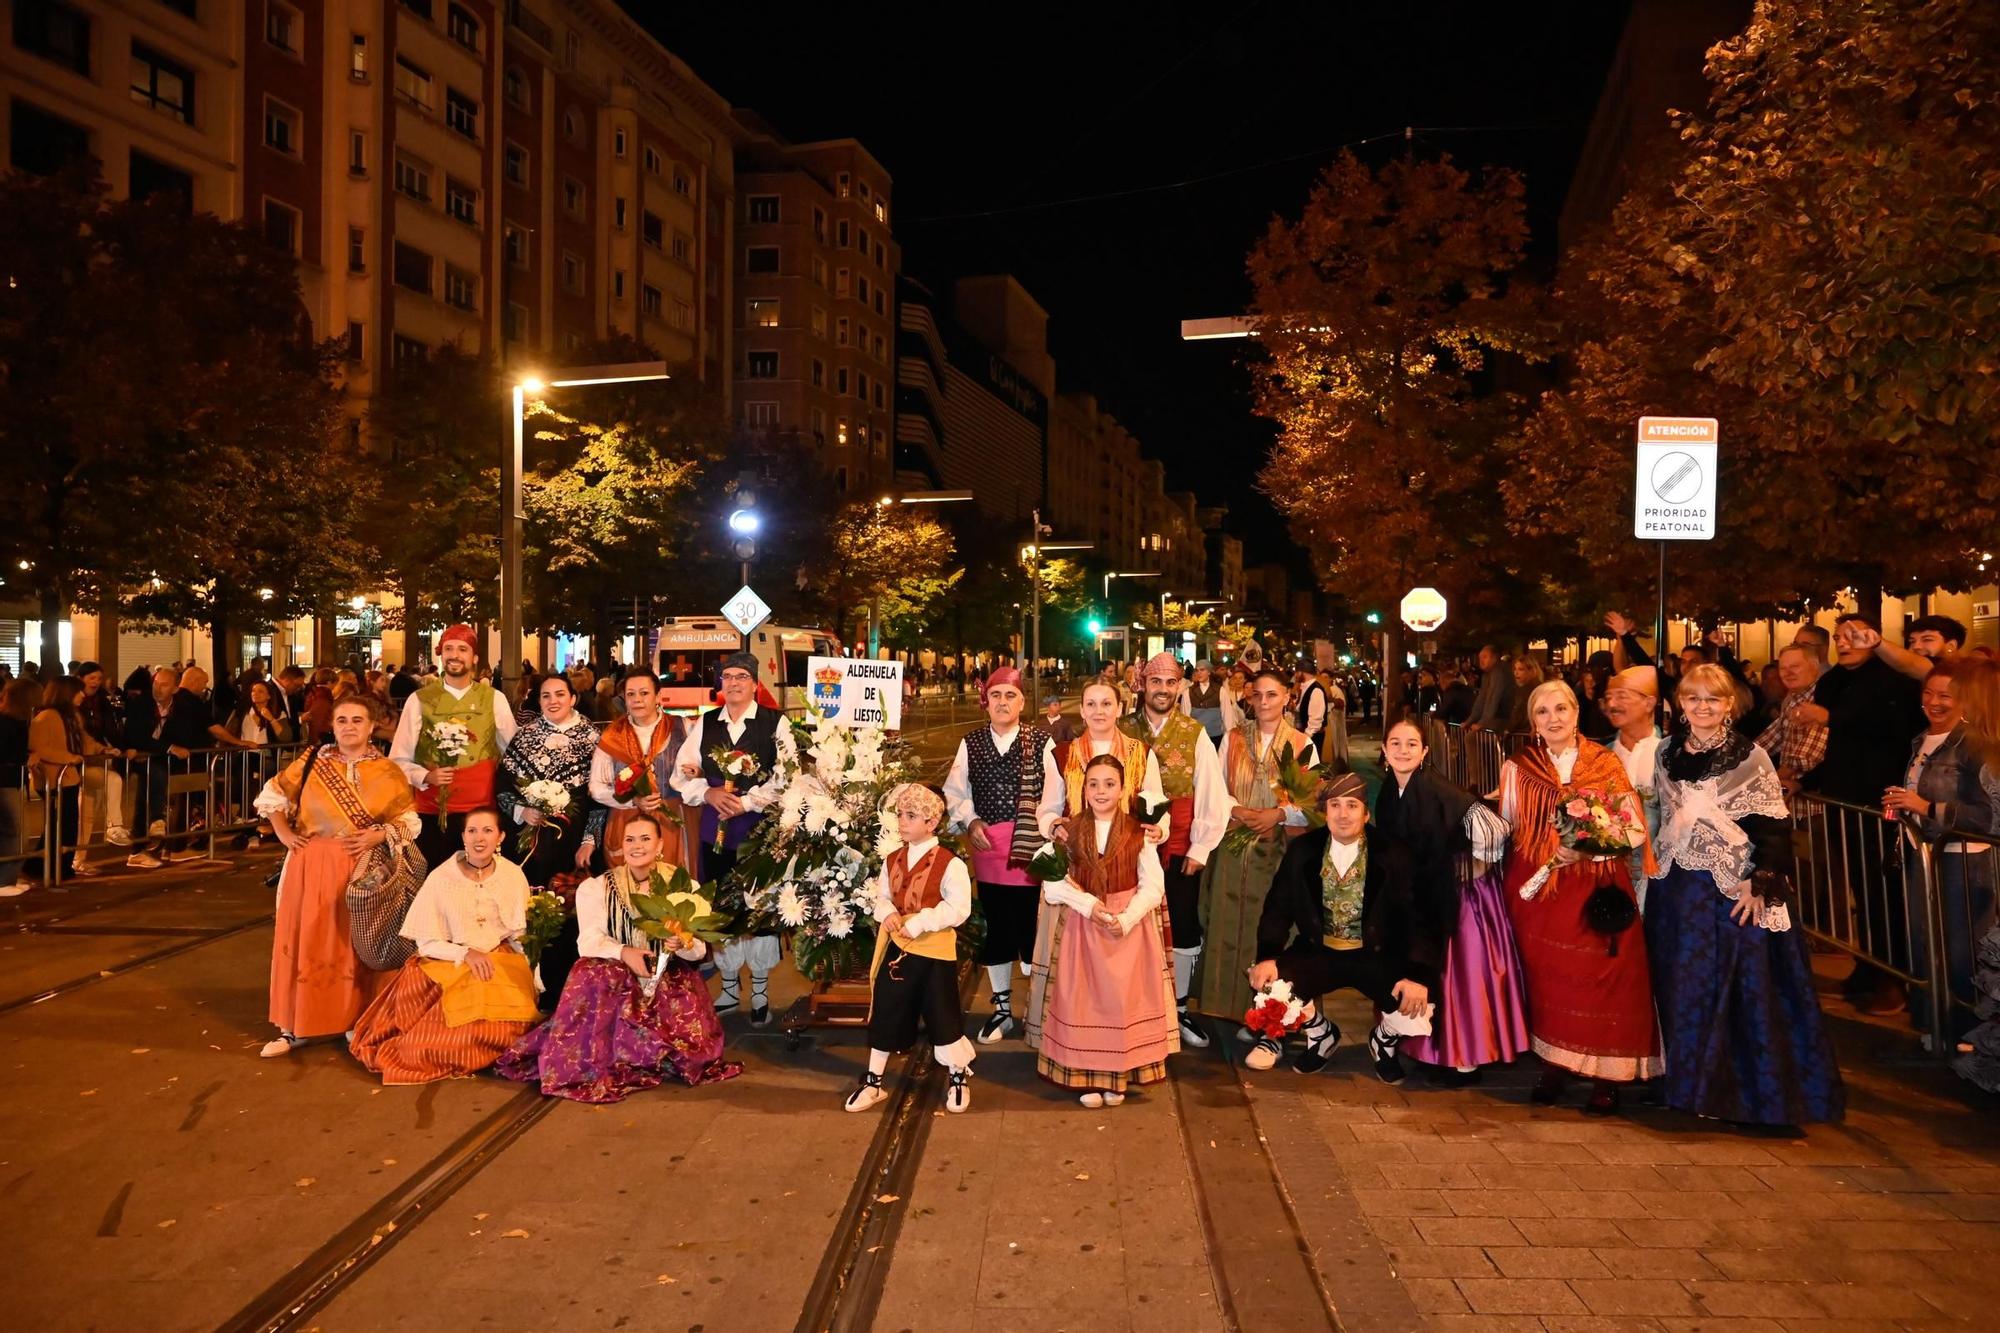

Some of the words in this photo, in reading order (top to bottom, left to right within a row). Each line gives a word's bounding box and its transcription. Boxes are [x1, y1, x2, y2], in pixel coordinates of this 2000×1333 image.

[1645, 508, 1707, 518] PRIORIDAD
[1645, 522, 1705, 532] PEATONAL
[735, 602, 757, 619] 30
[671, 633, 737, 643] AMBULANCIA
[847, 664, 897, 680] ALDEHUELA
[864, 687, 876, 701] DE
[854, 708, 884, 723] LIESTO
